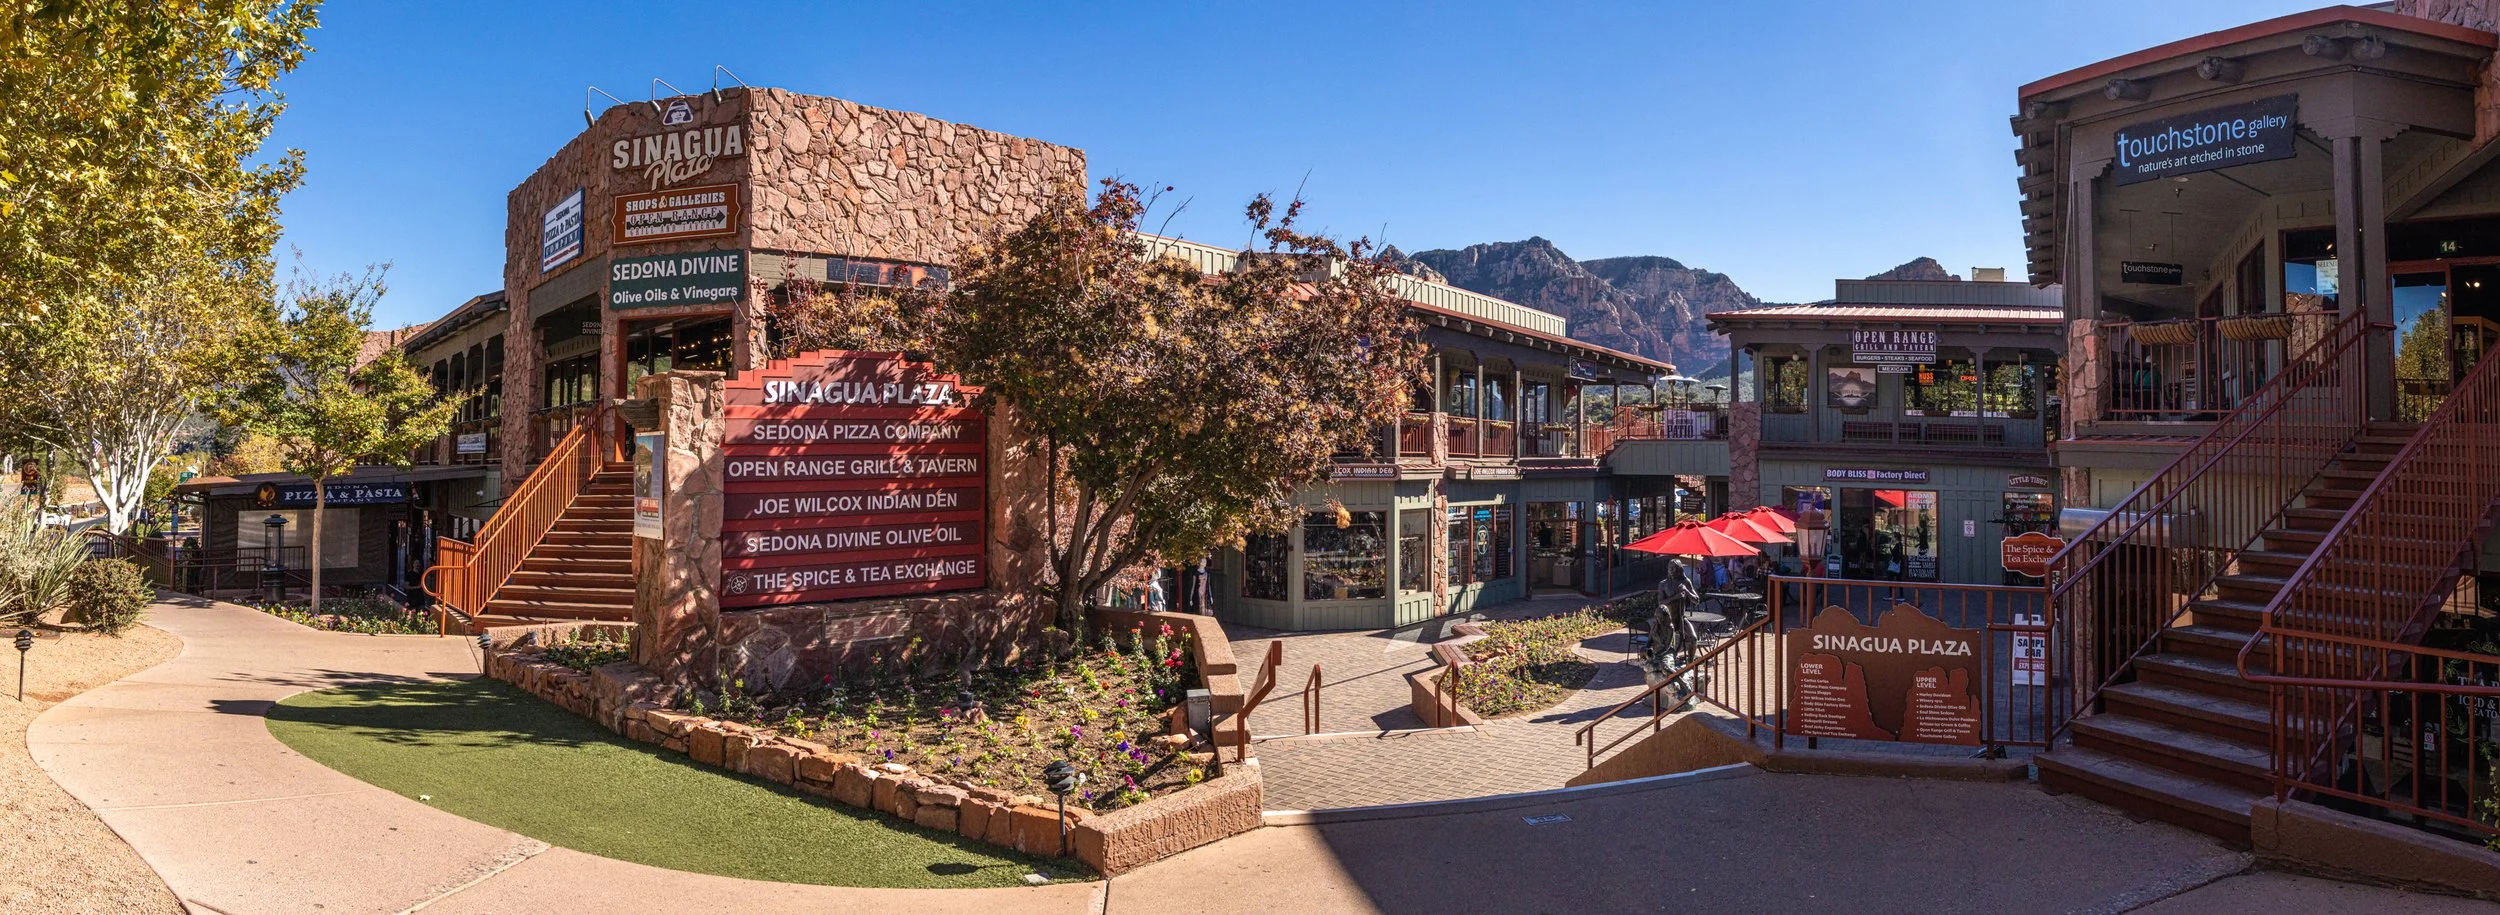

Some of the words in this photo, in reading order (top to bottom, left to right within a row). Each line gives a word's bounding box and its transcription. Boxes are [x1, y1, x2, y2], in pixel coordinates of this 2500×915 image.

[613, 125, 743, 169] SINAGUA
[2117, 118, 2246, 168] touchstone
[2248, 115, 2287, 137] gallery
[2138, 157, 2172, 173] nature's
[2174, 155, 2187, 167] art
[2190, 148, 2223, 164] etched
[2225, 146, 2235, 158] in
[2237, 143, 2265, 157] stone
[643, 154, 714, 191] Plaza
[625, 198, 658, 212] SHOPS
[658, 195, 667, 209] &
[669, 191, 726, 207] GALLERIES
[630, 212, 664, 226] OPEN
[671, 207, 718, 221] RANGE
[2442, 241, 2456, 251] 14
[612, 260, 677, 281] SEDONA
[681, 254, 738, 276] DIVINE
[2123, 263, 2168, 274] touchstone
[612, 291, 642, 304] Olive
[644, 288, 668, 302] Oils
[670, 288, 680, 300] &
[682, 285, 738, 301] Vinegars
[1855, 331, 1886, 344] OPEN
[1893, 331, 1934, 344] RANGE
[764, 380, 878, 404] SINAGUA
[883, 381, 953, 404] PLAZA
[753, 424, 828, 441] SEDONA
[833, 424, 880, 440] PIZZA
[884, 424, 962, 440] COMPANY
[728, 461, 778, 477] OPEN
[784, 460, 845, 476] RANGE
[850, 459, 899, 475] GRILL
[903, 459, 914, 474] &
[918, 458, 977, 473] TAVERN
[1826, 469, 1846, 478] BODY
[1847, 470, 1866, 478] BLISS
[1876, 470, 1902, 480] Factory
[1904, 471, 1926, 479] Direct
[2009, 476, 2029, 485] LITTLE
[2030, 476, 2048, 485] TIBET
[284, 490, 334, 500] PIZZA
[339, 491, 349, 499] &
[355, 488, 402, 498] PASTA
[753, 498, 789, 515] JOE
[795, 496, 862, 513] WILCOX
[867, 494, 921, 510] INDIAN
[926, 492, 958, 508] DEN
[746, 534, 822, 552] SEDONA
[827, 531, 881, 549] DIVINE
[886, 528, 932, 545] OLIVE
[936, 527, 962, 542] OIL
[2005, 545, 2021, 553] The
[2022, 545, 2044, 555] Spice
[2046, 545, 2053, 553] &
[753, 573, 787, 589] THE
[792, 569, 840, 587] SPICE
[844, 568, 856, 583] &
[861, 567, 891, 582] TEA
[895, 559, 976, 580] EXCHANGE
[1813, 634, 1903, 654] SINAGUA
[1907, 638, 1972, 656] PLAZA
[2017, 638, 2045, 648] SAPL
[2487, 699, 2496, 710] &
